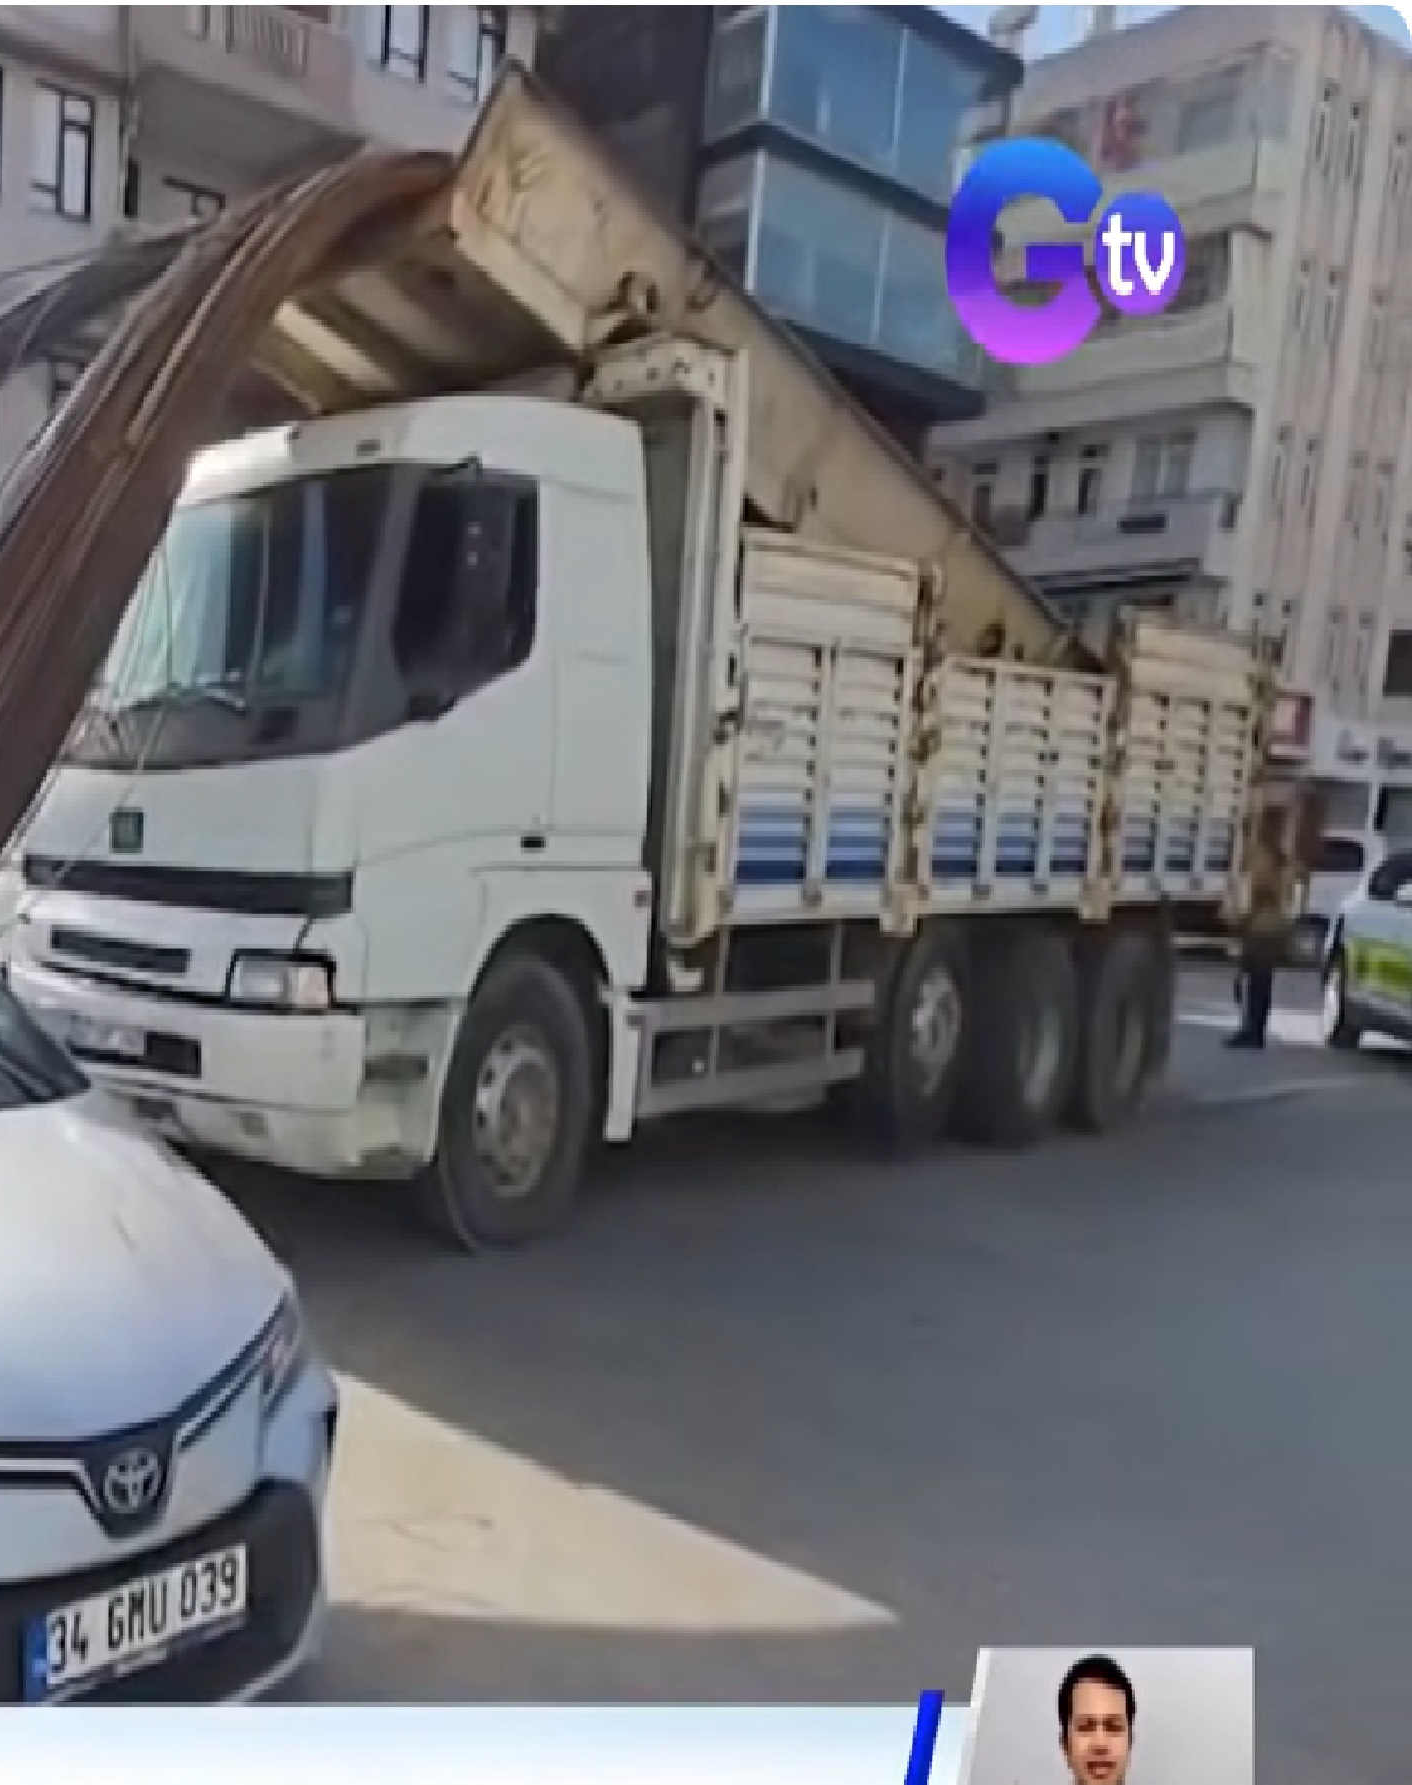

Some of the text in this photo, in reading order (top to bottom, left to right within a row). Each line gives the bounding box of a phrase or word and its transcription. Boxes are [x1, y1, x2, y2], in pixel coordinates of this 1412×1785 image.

[49, 1554, 238, 1675] 34 GMU 039
